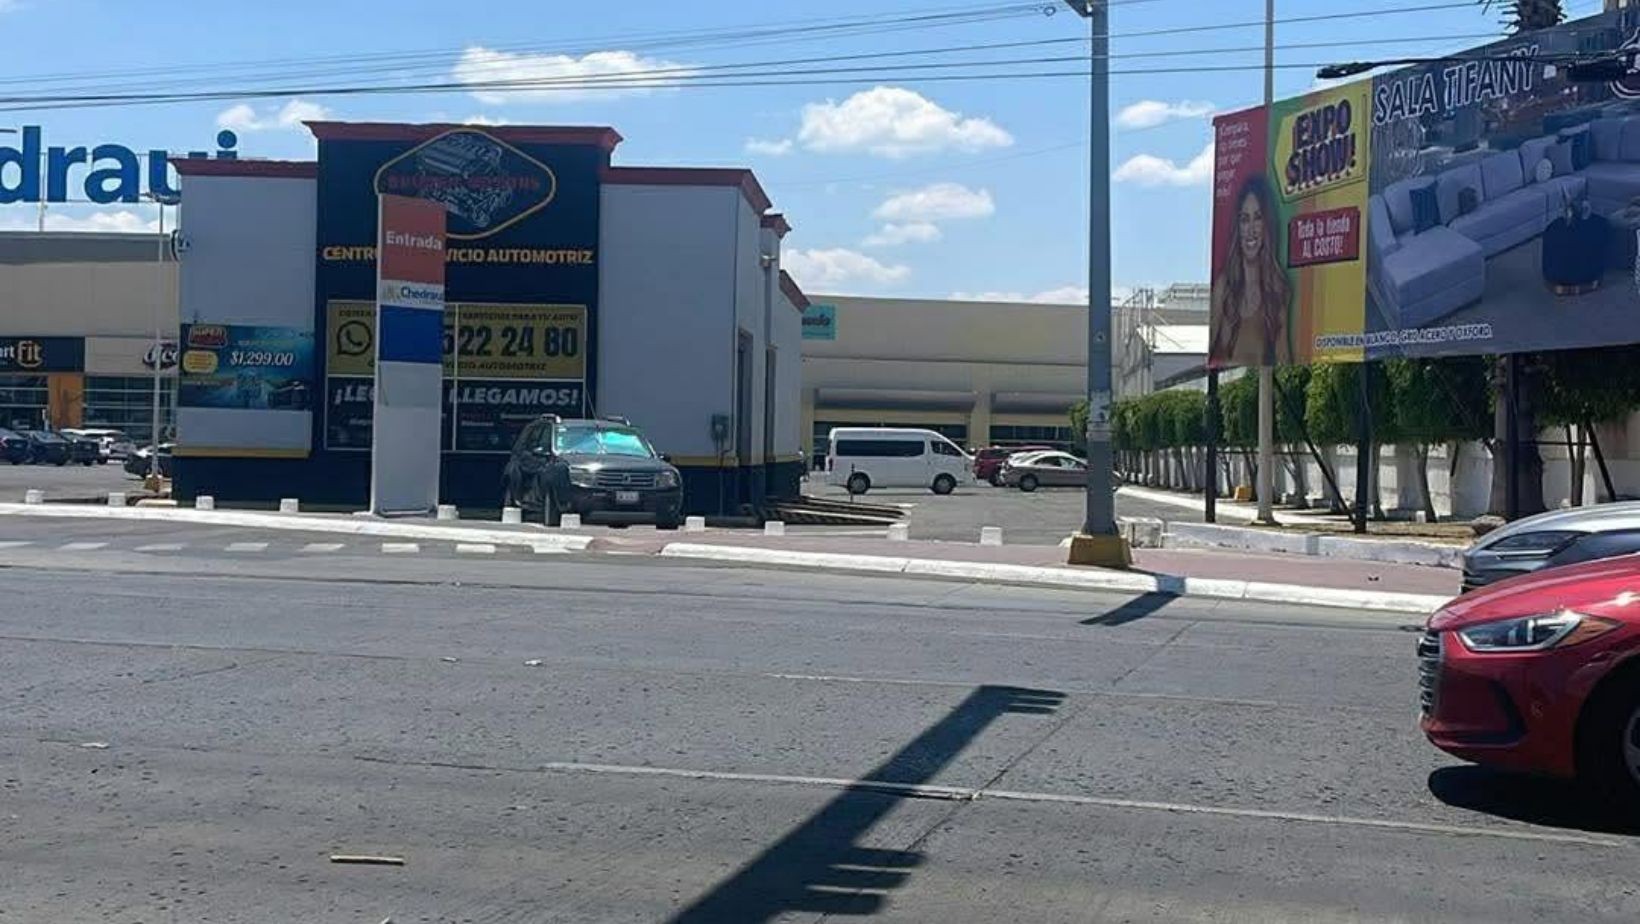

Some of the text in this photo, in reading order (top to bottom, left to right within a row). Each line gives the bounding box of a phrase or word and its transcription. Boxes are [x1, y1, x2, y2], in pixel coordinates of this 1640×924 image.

[1374, 44, 1538, 126] SALA TIFANY
[1285, 132, 1356, 193] SHOW!
[385, 231, 443, 250] Entrada
[446, 248, 485, 263] VICIO
[487, 249, 593, 264] AUTOMOTRIZ
[400, 285, 443, 301] Chedrau
[18, 340, 43, 361] fit
[500, 326, 534, 357] 24
